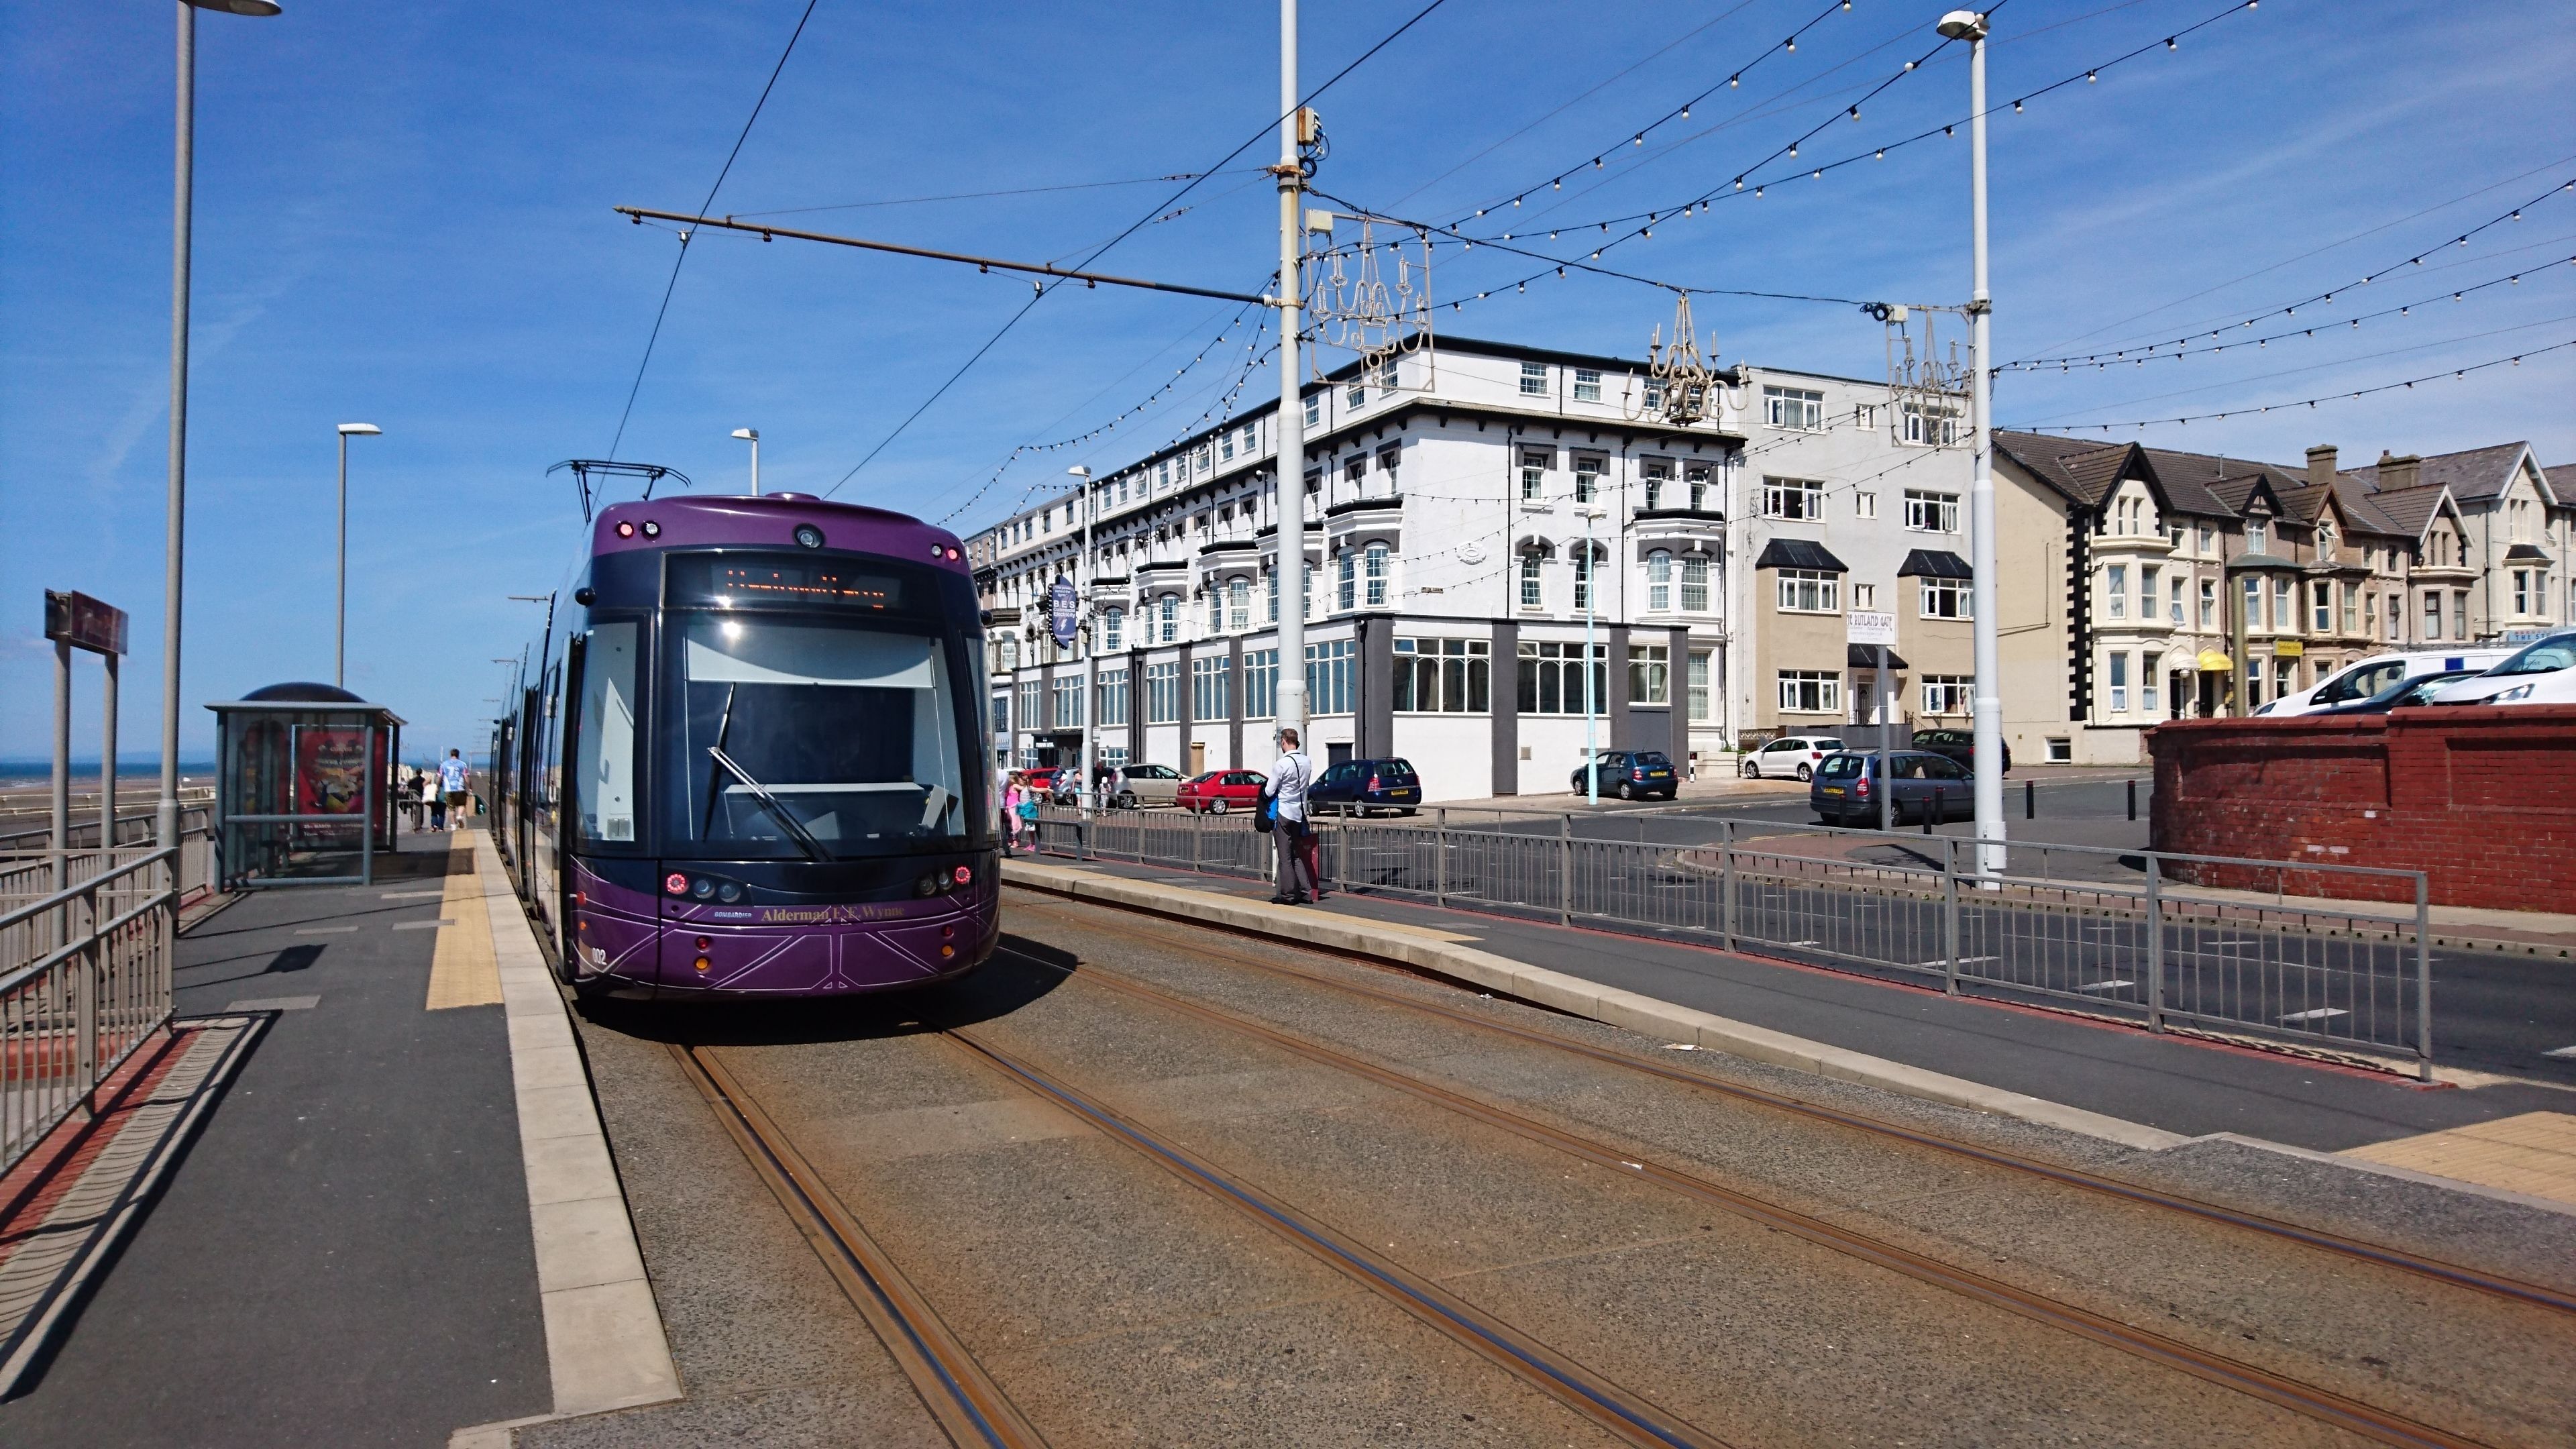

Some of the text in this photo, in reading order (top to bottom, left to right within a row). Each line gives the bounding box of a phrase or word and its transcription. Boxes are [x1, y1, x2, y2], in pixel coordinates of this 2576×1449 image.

[1854, 614, 1878, 627] RUTLAND
[1880, 615, 1892, 631] GATE
[761, 907, 829, 922] Alderman
[862, 905, 905, 920] Wynne
[592, 947, 607, 965] 002
